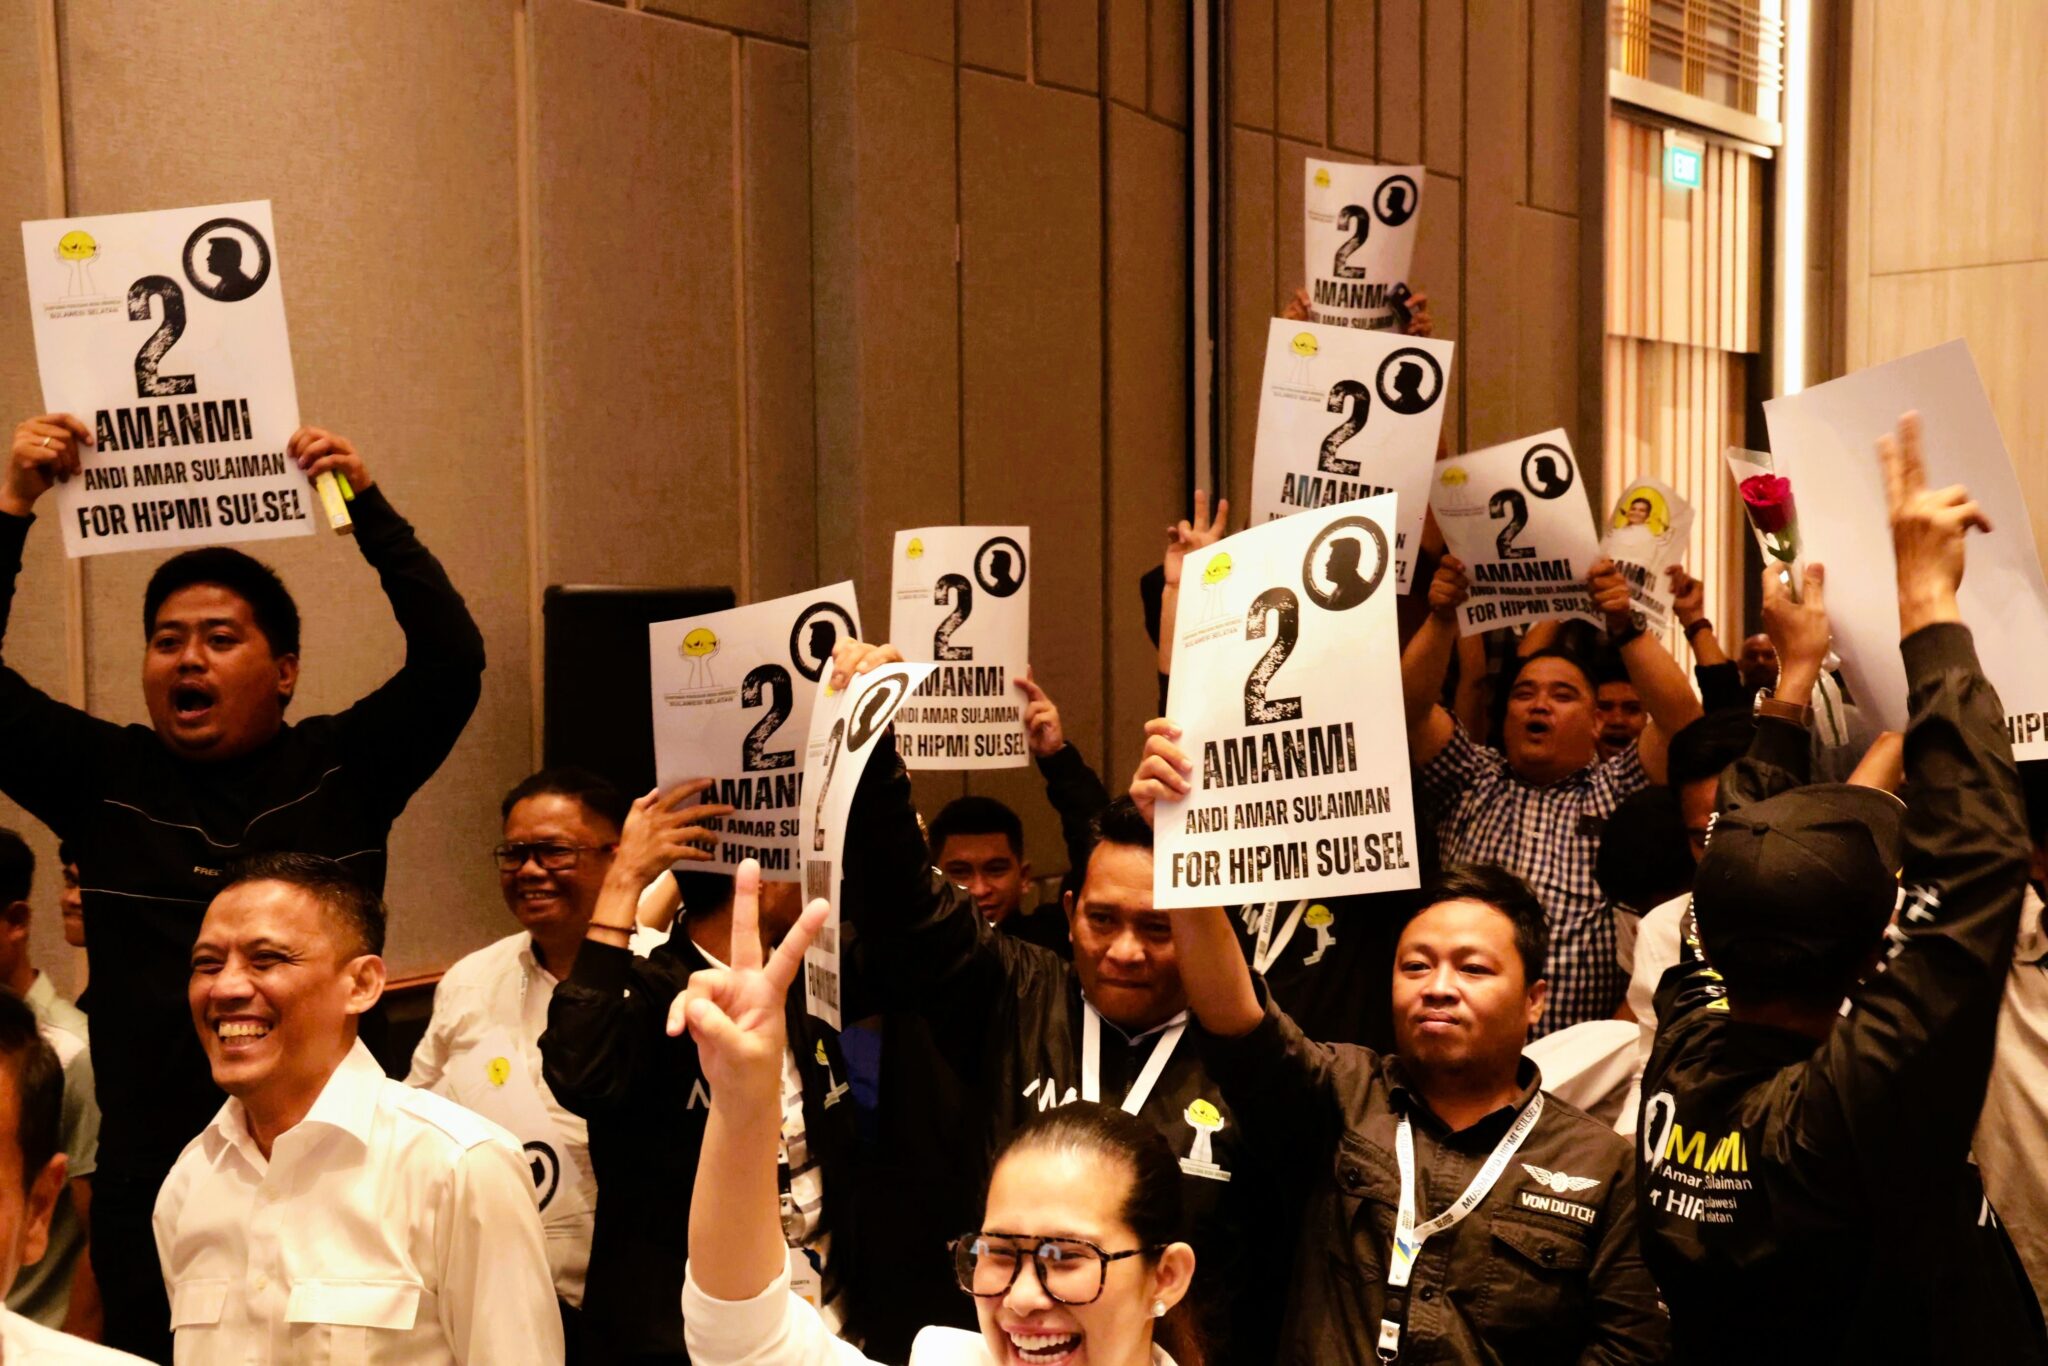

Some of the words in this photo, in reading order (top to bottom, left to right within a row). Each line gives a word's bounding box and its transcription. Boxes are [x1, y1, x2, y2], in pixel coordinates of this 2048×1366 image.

[1333, 204, 1370, 279] 2
[127, 274, 197, 398] 2
[96, 398, 252, 452] AMANMI
[1317, 379, 1371, 477] 2
[85, 466, 128, 491] ANDI
[133, 461, 188, 487] AMAR
[191, 453, 286, 482] SULAIMAN
[77, 503, 129, 538] FOR
[132, 497, 212, 532] HIPMI
[216, 489, 306, 526] SULSEL
[1489, 488, 1537, 559] 2
[1474, 559, 1573, 582] AMANMI
[934, 573, 973, 661] 2
[1466, 602, 1498, 625] FOR
[1500, 598, 1549, 618] HIPMI
[912, 666, 1004, 696] MANMI
[1245, 586, 1303, 727] 2
[741, 664, 796, 772] 2
[921, 707, 958, 724] AMAR
[961, 706, 1020, 724] SULAIMAN
[917, 734, 969, 757] HIPMI
[974, 732, 1026, 757] SULSEL
[1202, 722, 1358, 790] AMANMI
[727, 818, 776, 837] AMAR
[1185, 805, 1229, 834] ANDI
[1234, 798, 1289, 830] AMAR
[1293, 786, 1391, 823] SULAIMAN
[1172, 850, 1221, 888] FOR
[1229, 841, 1310, 885] HIPMI
[1316, 831, 1410, 877] SULSEL
[1662, 1165, 1703, 1188] Amar
[1521, 1192, 1550, 1210] VON
[1550, 1199, 1596, 1223] DUTCH
